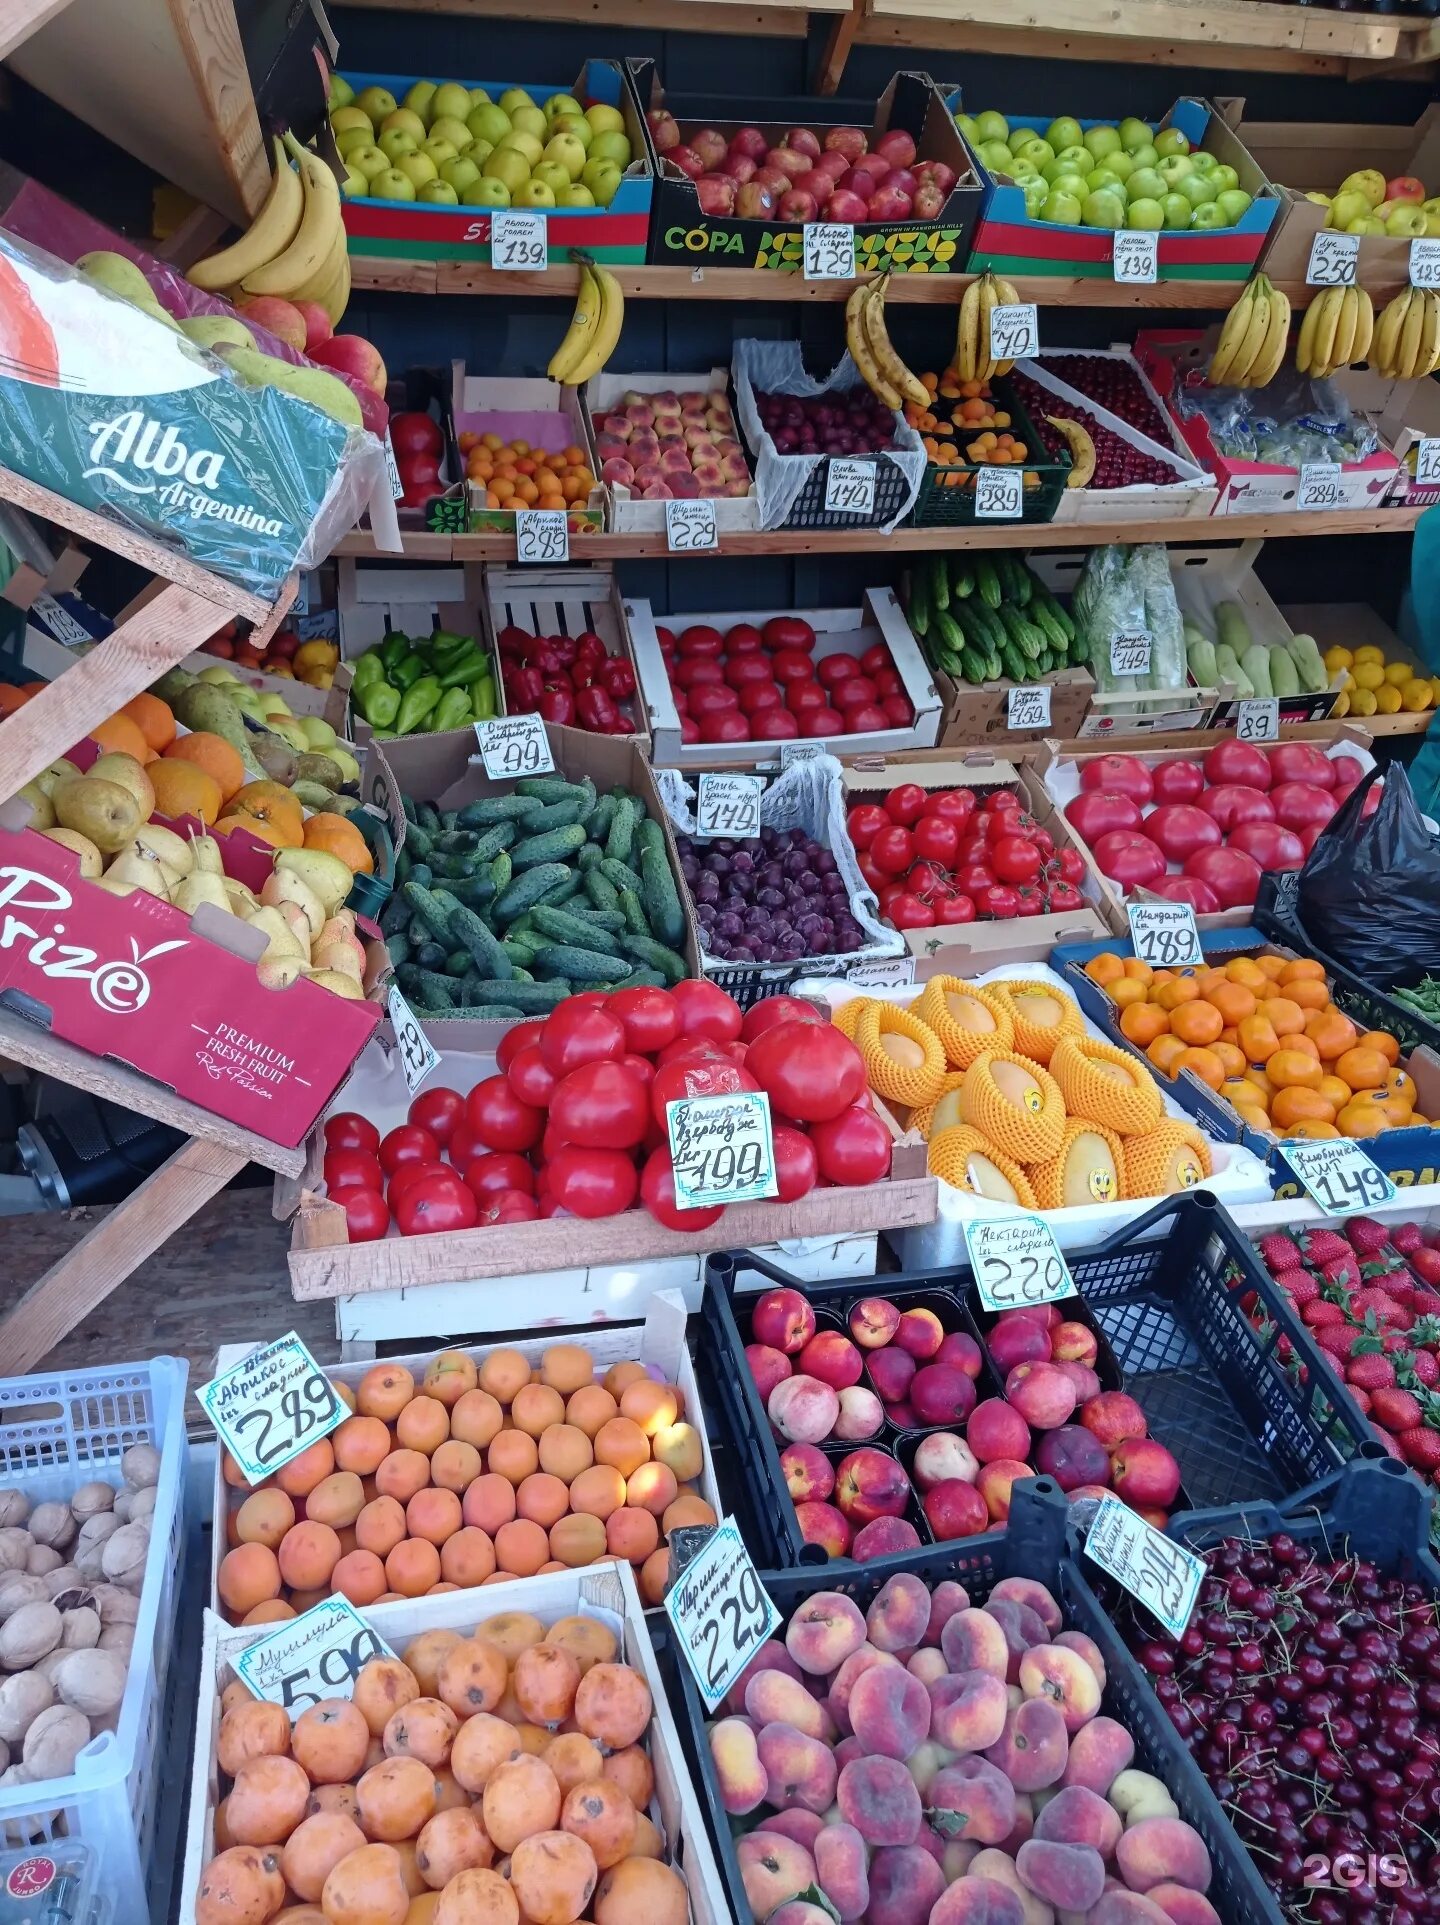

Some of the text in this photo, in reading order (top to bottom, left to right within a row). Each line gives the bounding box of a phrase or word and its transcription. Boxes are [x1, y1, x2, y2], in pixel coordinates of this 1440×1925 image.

[1319, 237, 1337, 251] Лук
[809, 249, 853, 276] 129
[1313, 256, 1357, 283] 250
[89, 411, 225, 490] Alba
[833, 463, 858, 473] Слива
[159, 481, 284, 537] Argentina
[978, 488, 1018, 511] 289
[523, 512, 563, 530] Абрикос
[671, 521, 716, 547] 229
[519, 530, 566, 559] 289
[706, 781, 740, 791] Слива
[1136, 909, 1188, 924] Мандарин
[1139, 928, 1195, 964] 189
[205, 1037, 288, 1084] FRESH FRUIT
[215, 1022, 296, 1073] PREMIUM
[226, 1066, 273, 1100] Passion
[1315, 1167, 1389, 1211] 149
[980, 1226, 1044, 1244] Нектарин
[983, 1255, 1064, 1302] 220
[217, 1358, 287, 1408] Абрикос
[234, 1372, 338, 1464] 289
[253, 1611, 350, 1673] Мушмула
[701, 1566, 771, 1690] 229
[17, 1866, 47, 1885] R
[22, 1859, 51, 1870] ROYAL
[13, 1885, 41, 1896] JUMBO
